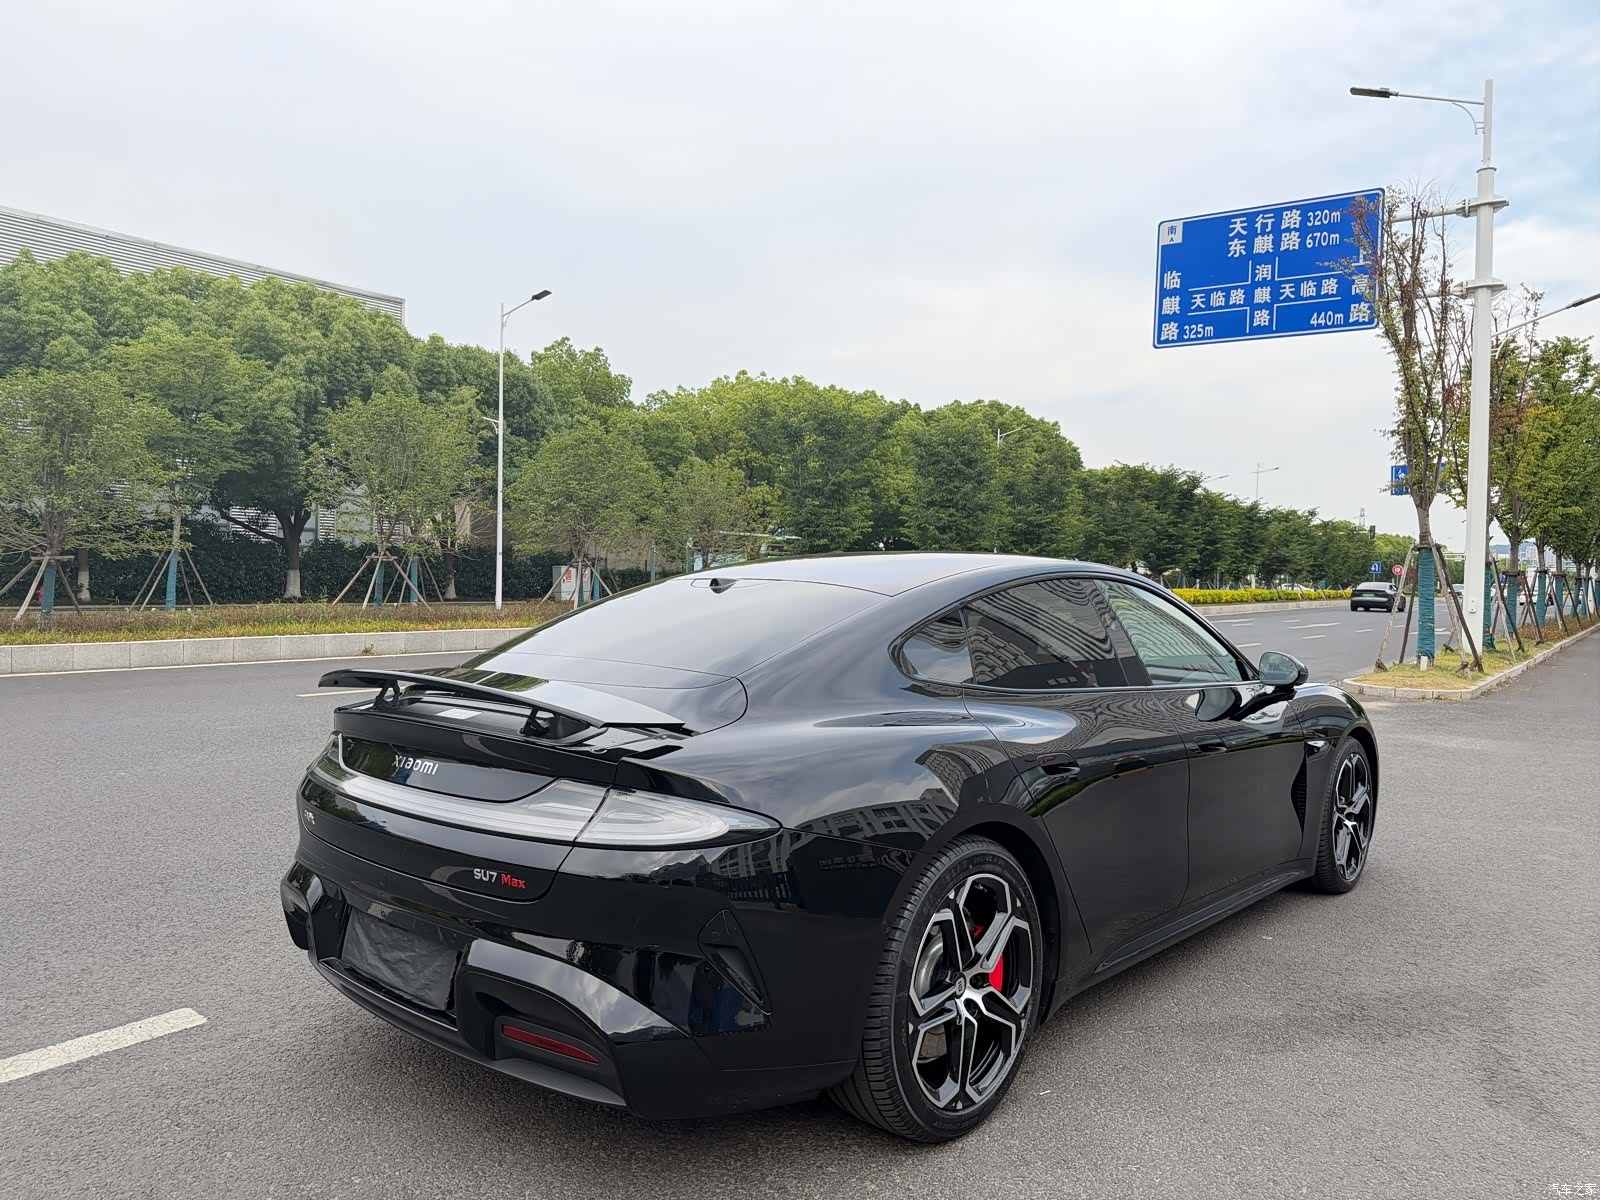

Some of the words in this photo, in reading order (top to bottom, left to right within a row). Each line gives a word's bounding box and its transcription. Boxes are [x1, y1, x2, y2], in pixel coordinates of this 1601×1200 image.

[1167, 225, 1177, 236] 南
[1228, 209, 1302, 237] 天行路
[1307, 210, 1341, 227] 320m
[1227, 231, 1302, 258] 东麒路
[1305, 231, 1340, 249] 670m
[1190, 288, 1246, 310] 天临路
[1253, 264, 1272, 327] 润麒路
[1279, 278, 1339, 300] 天临路
[1160, 270, 1181, 341] 临麒路
[1309, 310, 1344, 328] 440m
[1183, 323, 1214, 340] 325m
[391, 754, 439, 776] xiaomi
[473, 868, 498, 883] SU7
[501, 873, 526, 889] Max
